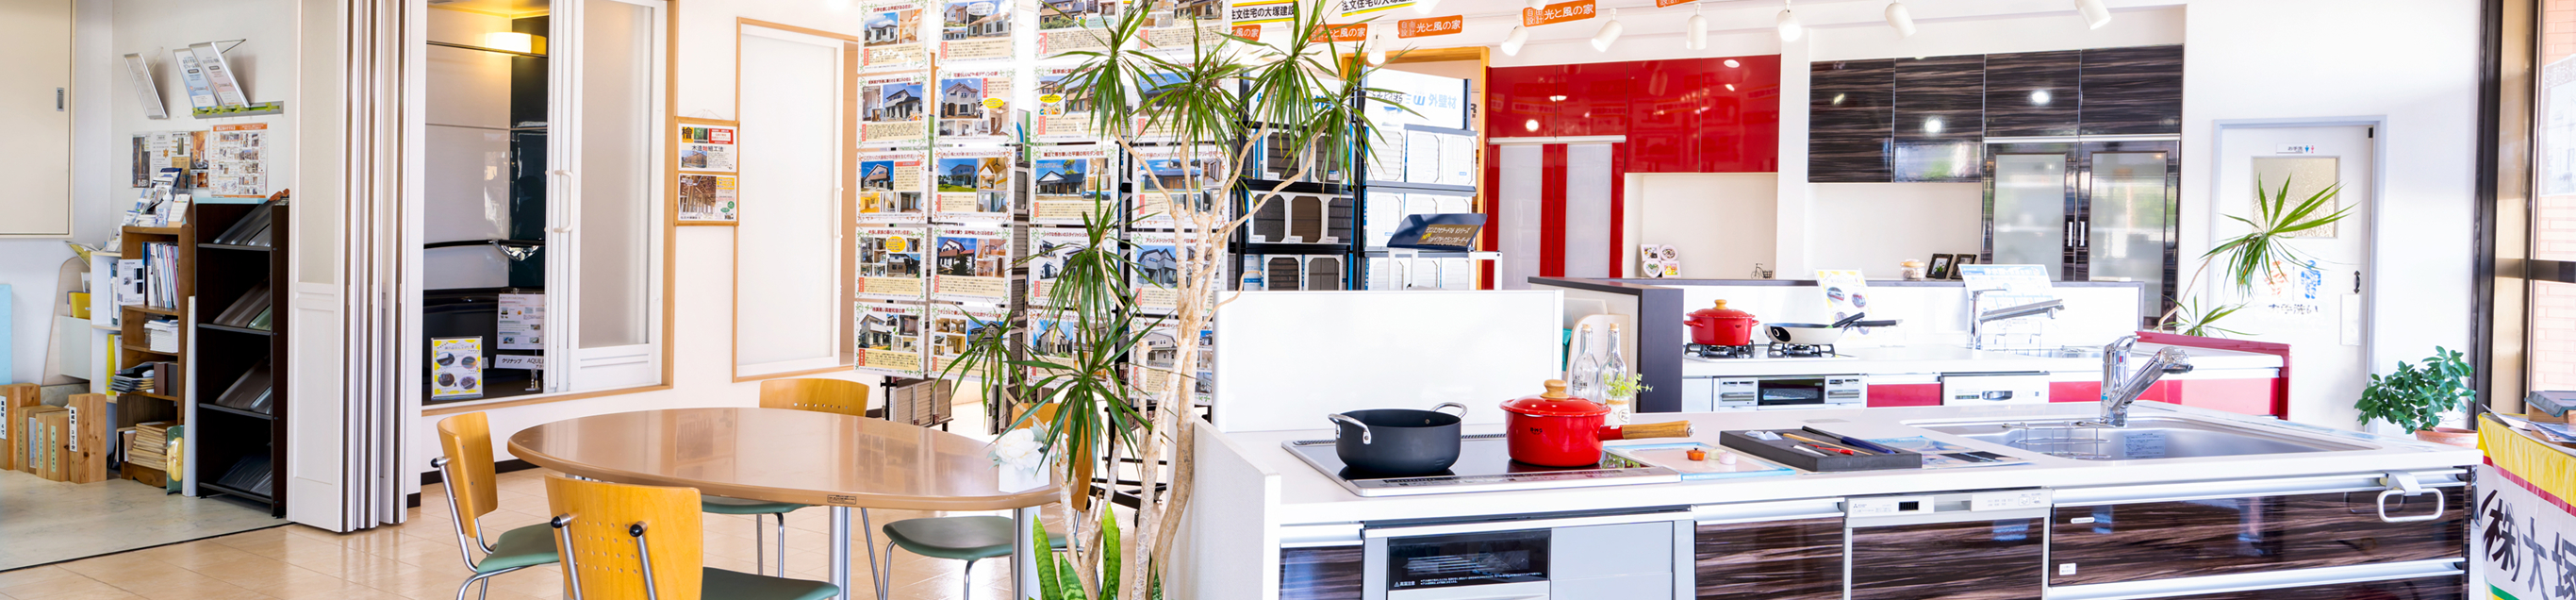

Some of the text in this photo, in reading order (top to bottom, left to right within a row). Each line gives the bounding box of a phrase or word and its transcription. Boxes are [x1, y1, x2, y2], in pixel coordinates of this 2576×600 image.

[1544, 4, 1594, 21] 光と風の家
[1231, 27, 1259, 39] 風の家
[1416, 20, 1461, 34] 光と風の家
